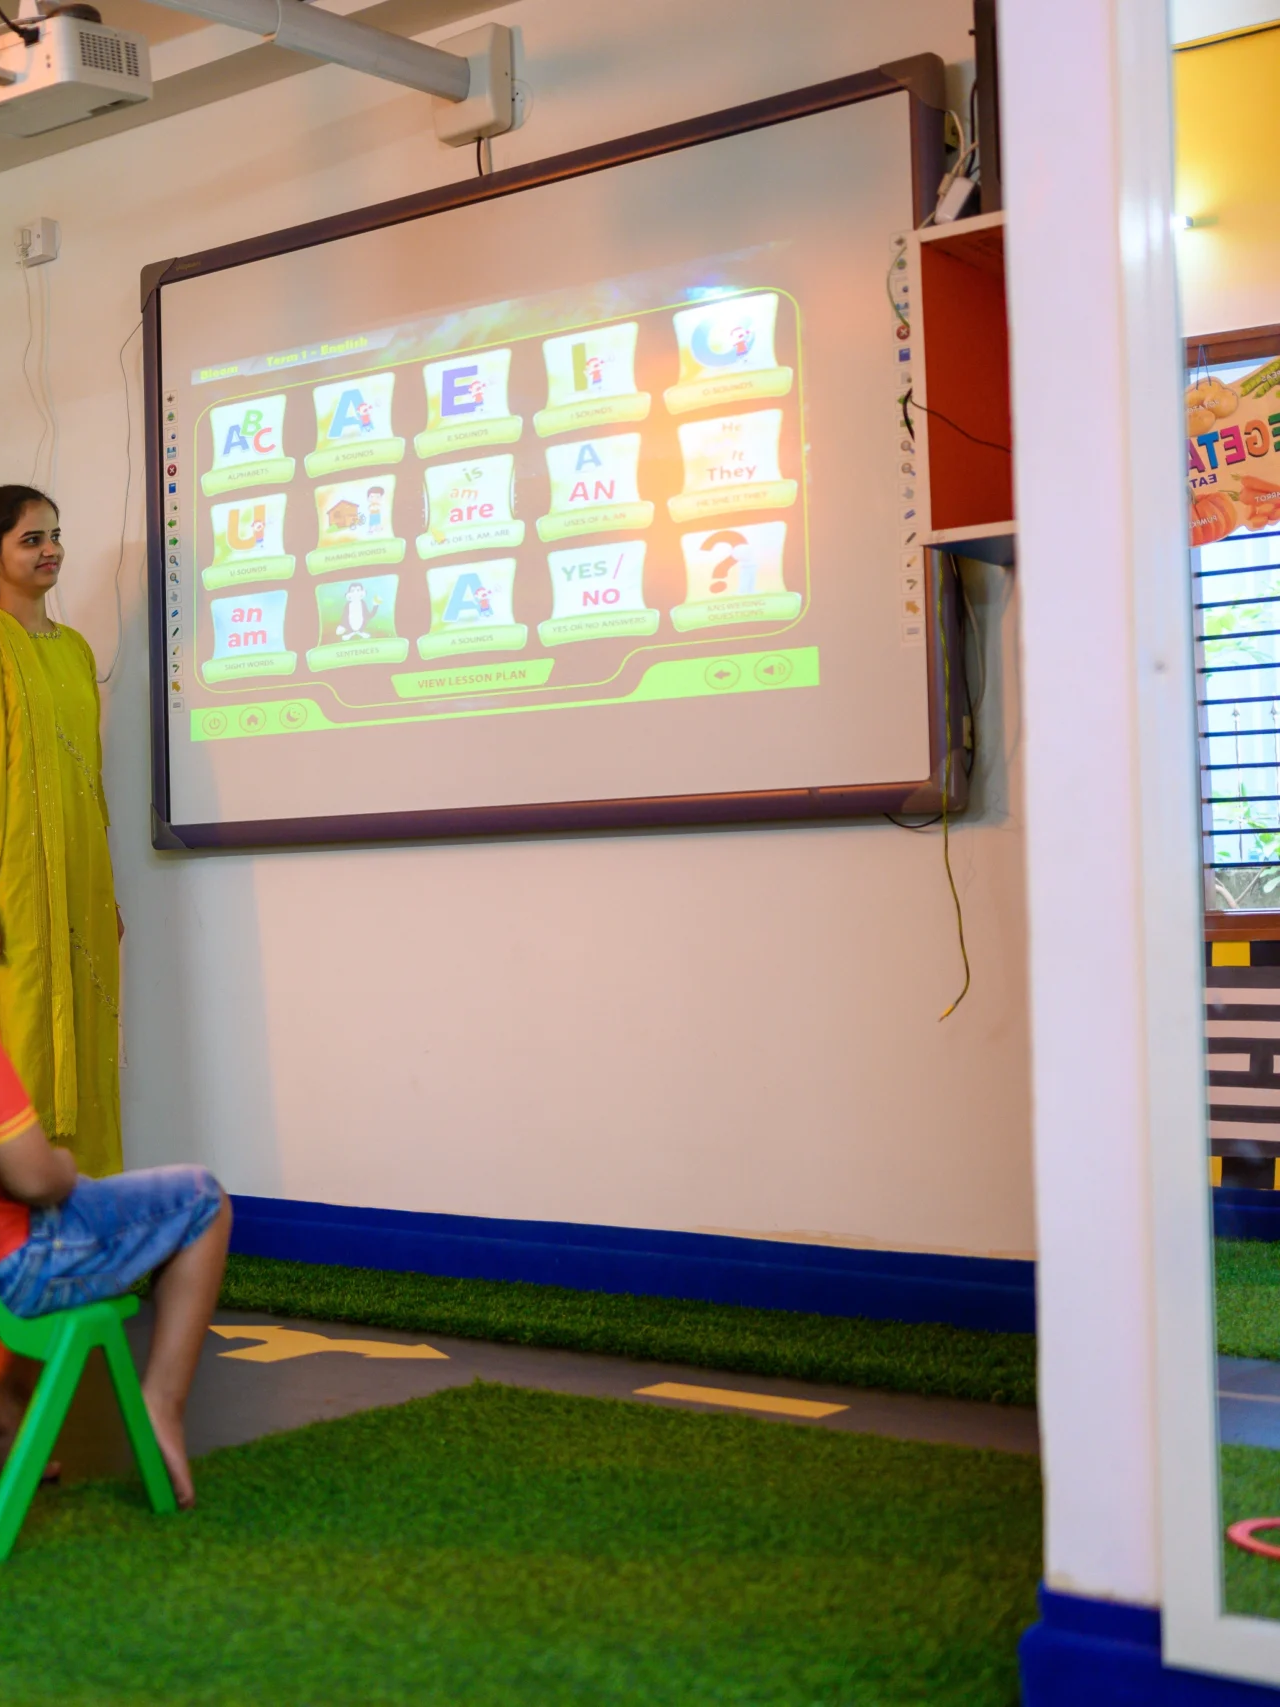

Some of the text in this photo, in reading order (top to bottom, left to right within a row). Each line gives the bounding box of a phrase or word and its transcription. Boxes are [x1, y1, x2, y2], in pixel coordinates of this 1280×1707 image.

[266, 355, 298, 368] Term
[320, 337, 368, 355] English
[441, 365, 478, 417] E
[328, 389, 369, 439] A
[575, 405, 613, 418] SOUNDS
[454, 428, 488, 440] SOUNDS
[342, 449, 374, 461] SOUNDS
[575, 443, 603, 471] A
[227, 468, 269, 480] ALPHABETS
[462, 466, 483, 482] is
[706, 465, 758, 482] They
[450, 488, 478, 499] am
[569, 480, 615, 502] AN
[449, 503, 494, 523] are
[227, 504, 266, 550] U
[494, 529, 510, 537] ARE
[358, 547, 387, 557] WORDS
[236, 565, 267, 576] SOUNDS
[442, 572, 486, 622] A
[582, 588, 620, 606] NO
[231, 607, 263, 623] an
[552, 624, 568, 633] YES
[585, 621, 599, 629] NO
[602, 616, 646, 628] ANSWERS
[227, 629, 267, 648] am
[336, 647, 379, 657] SENTENCES
[224, 659, 274, 670] SIGHT WORDS
[418, 669, 527, 689] VIEW LESSON PLAN
